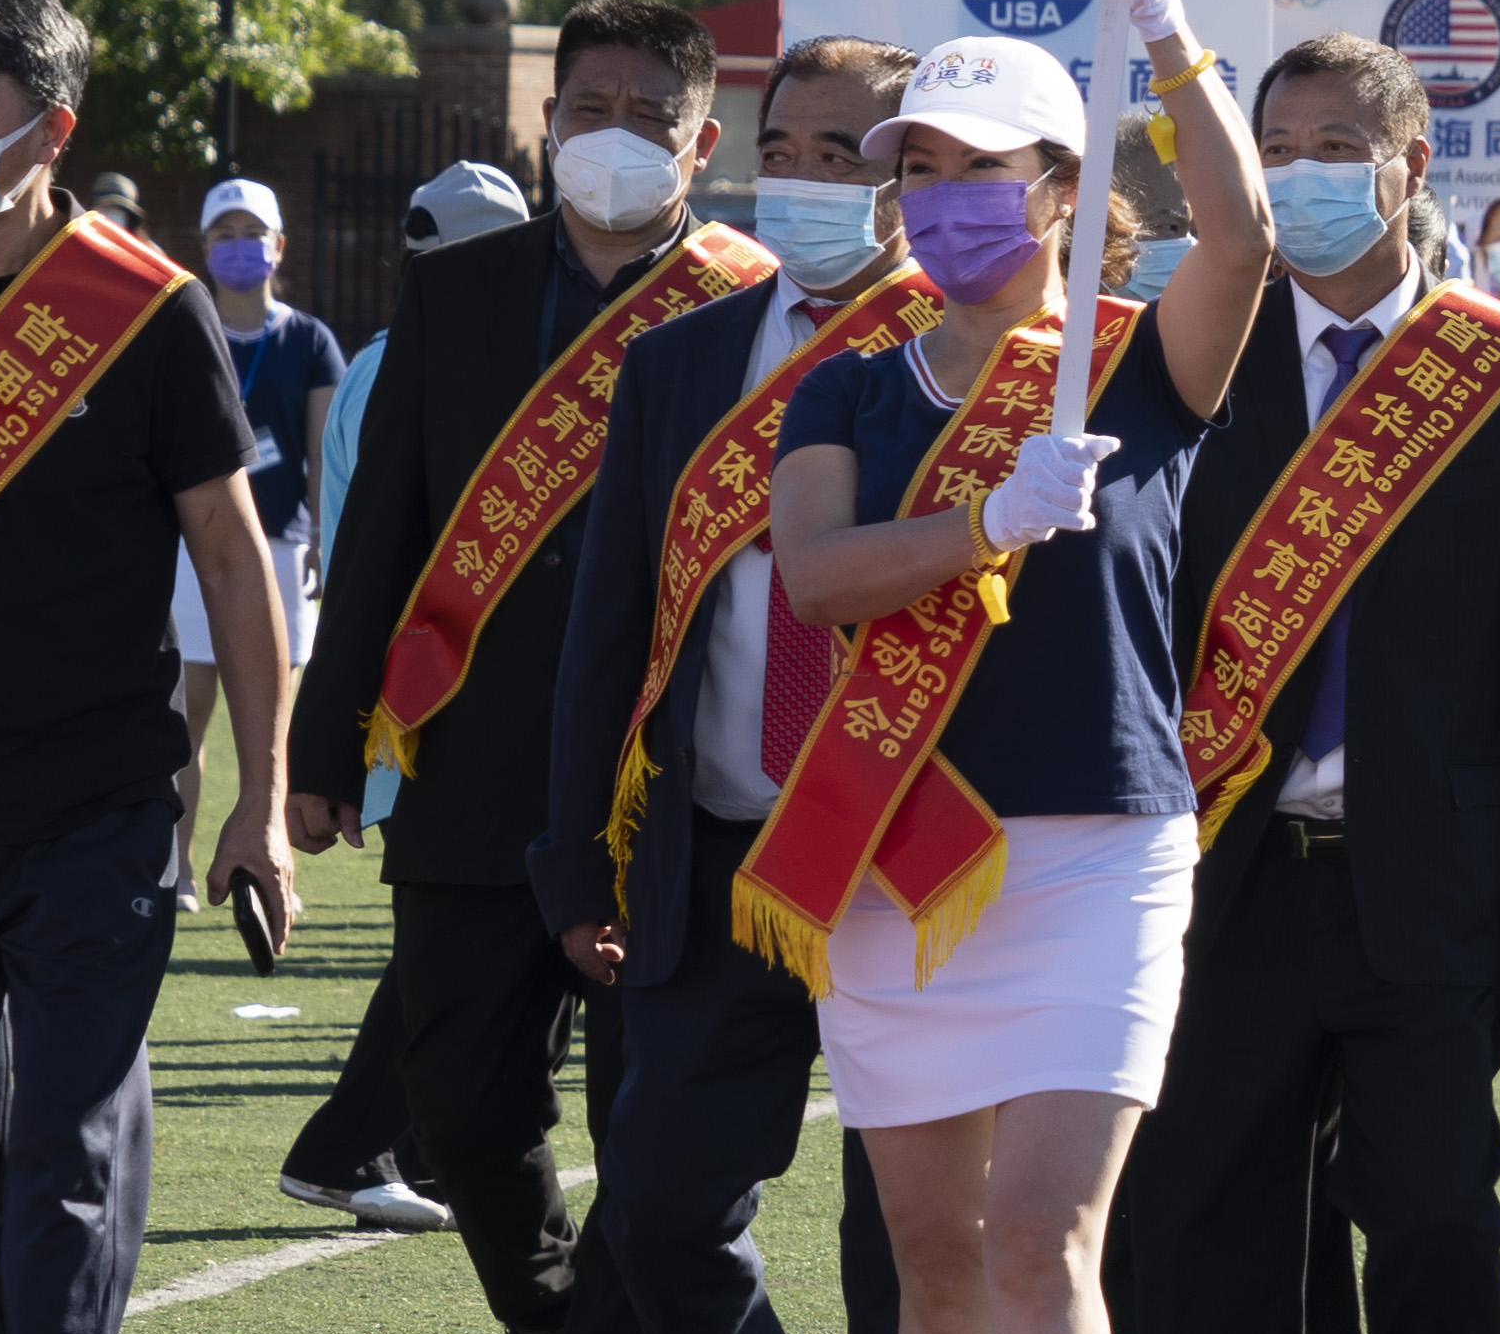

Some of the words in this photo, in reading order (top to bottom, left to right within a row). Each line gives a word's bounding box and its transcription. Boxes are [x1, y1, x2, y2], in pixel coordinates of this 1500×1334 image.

[990, 1, 1062, 28] USA
[50, 333, 99, 377] The
[18, 379, 58, 417] 1st
[1442, 375, 1483, 412] 1st
[1369, 410, 1455, 493] Chinese
[507, 459, 578, 530] Sports
[698, 472, 773, 553] merican
[1180, 309, 1477, 747] 首届华侨体育运动会
[472, 533, 519, 596] Game
[1293, 491, 1383, 604] American
[1237, 608, 1304, 690] Sports
[879, 665, 946, 758] Game
[1199, 696, 1254, 761] Game
